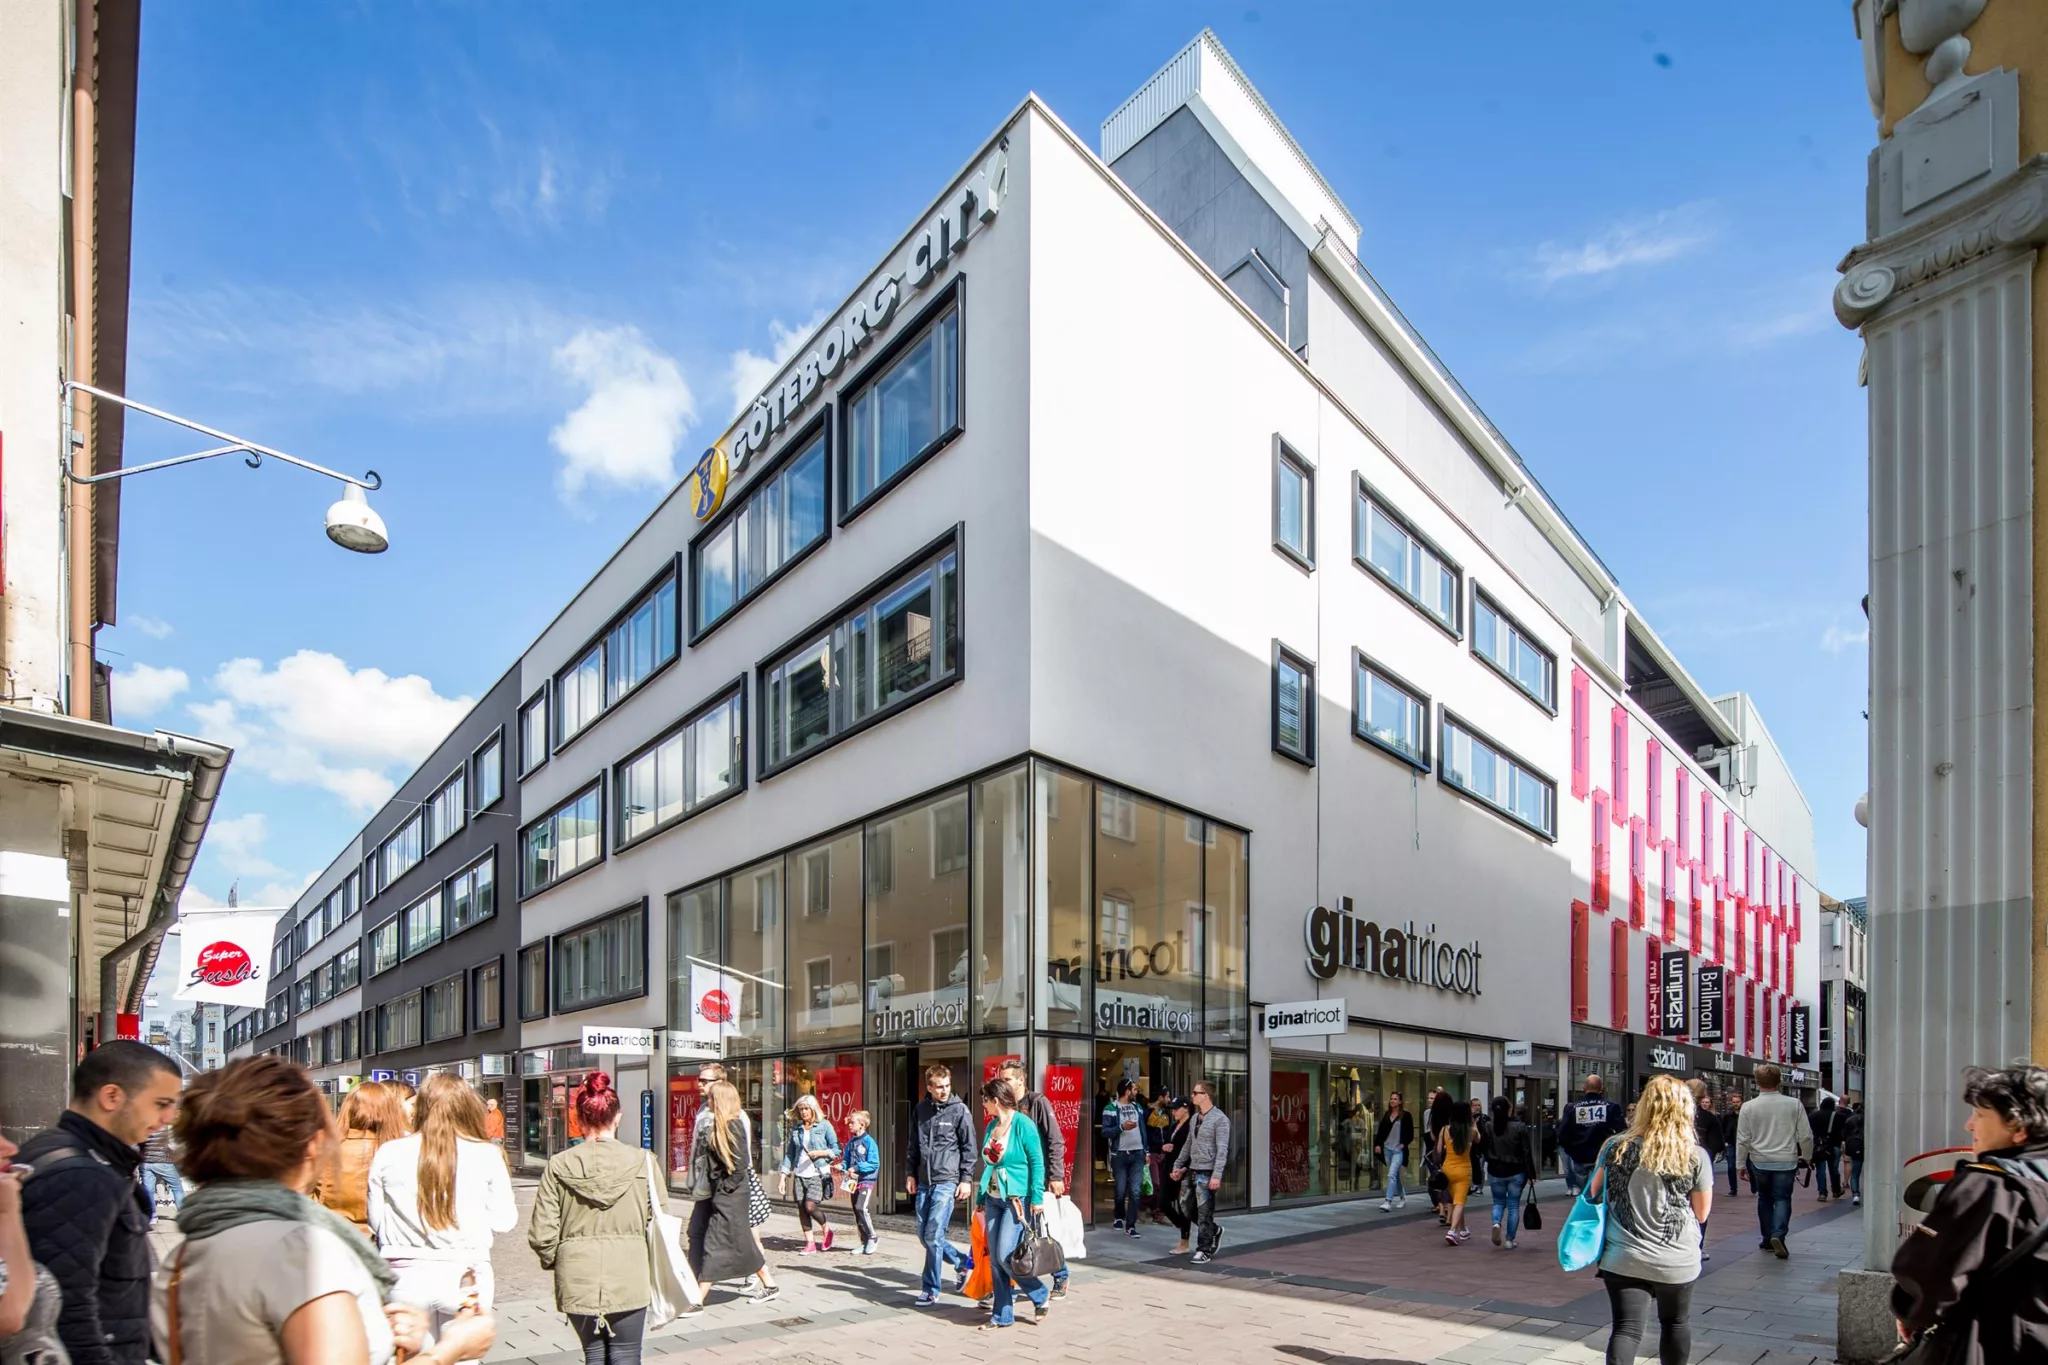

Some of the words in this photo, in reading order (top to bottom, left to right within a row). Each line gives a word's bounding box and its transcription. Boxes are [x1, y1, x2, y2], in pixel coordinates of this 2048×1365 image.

[729, 273, 900, 472] GÖTEBORG
[906, 148, 1007, 289] CITY
[203, 949, 243, 963] Super
[1306, 896, 1482, 995] ginatricot
[186, 961, 260, 987] Sushi
[1666, 958, 1683, 1028] stadium
[1701, 972, 1721, 1030] Brillman
[874, 998, 967, 1038] ginatricot
[1099, 997, 1192, 1032] ginatricot
[1268, 1007, 1340, 1029] ginatricot
[587, 1032, 651, 1047] ginatricot
[1652, 1045, 1686, 1072] stadium
[378, 1072, 390, 1082] P
[1051, 1075, 1075, 1092] 50%
[644, 1096, 651, 1115] P
[673, 1094, 697, 1119] 50%
[822, 1091, 858, 1121] 50%
[1271, 1094, 1306, 1122] 50%
[1588, 1107, 1605, 1121] 14
